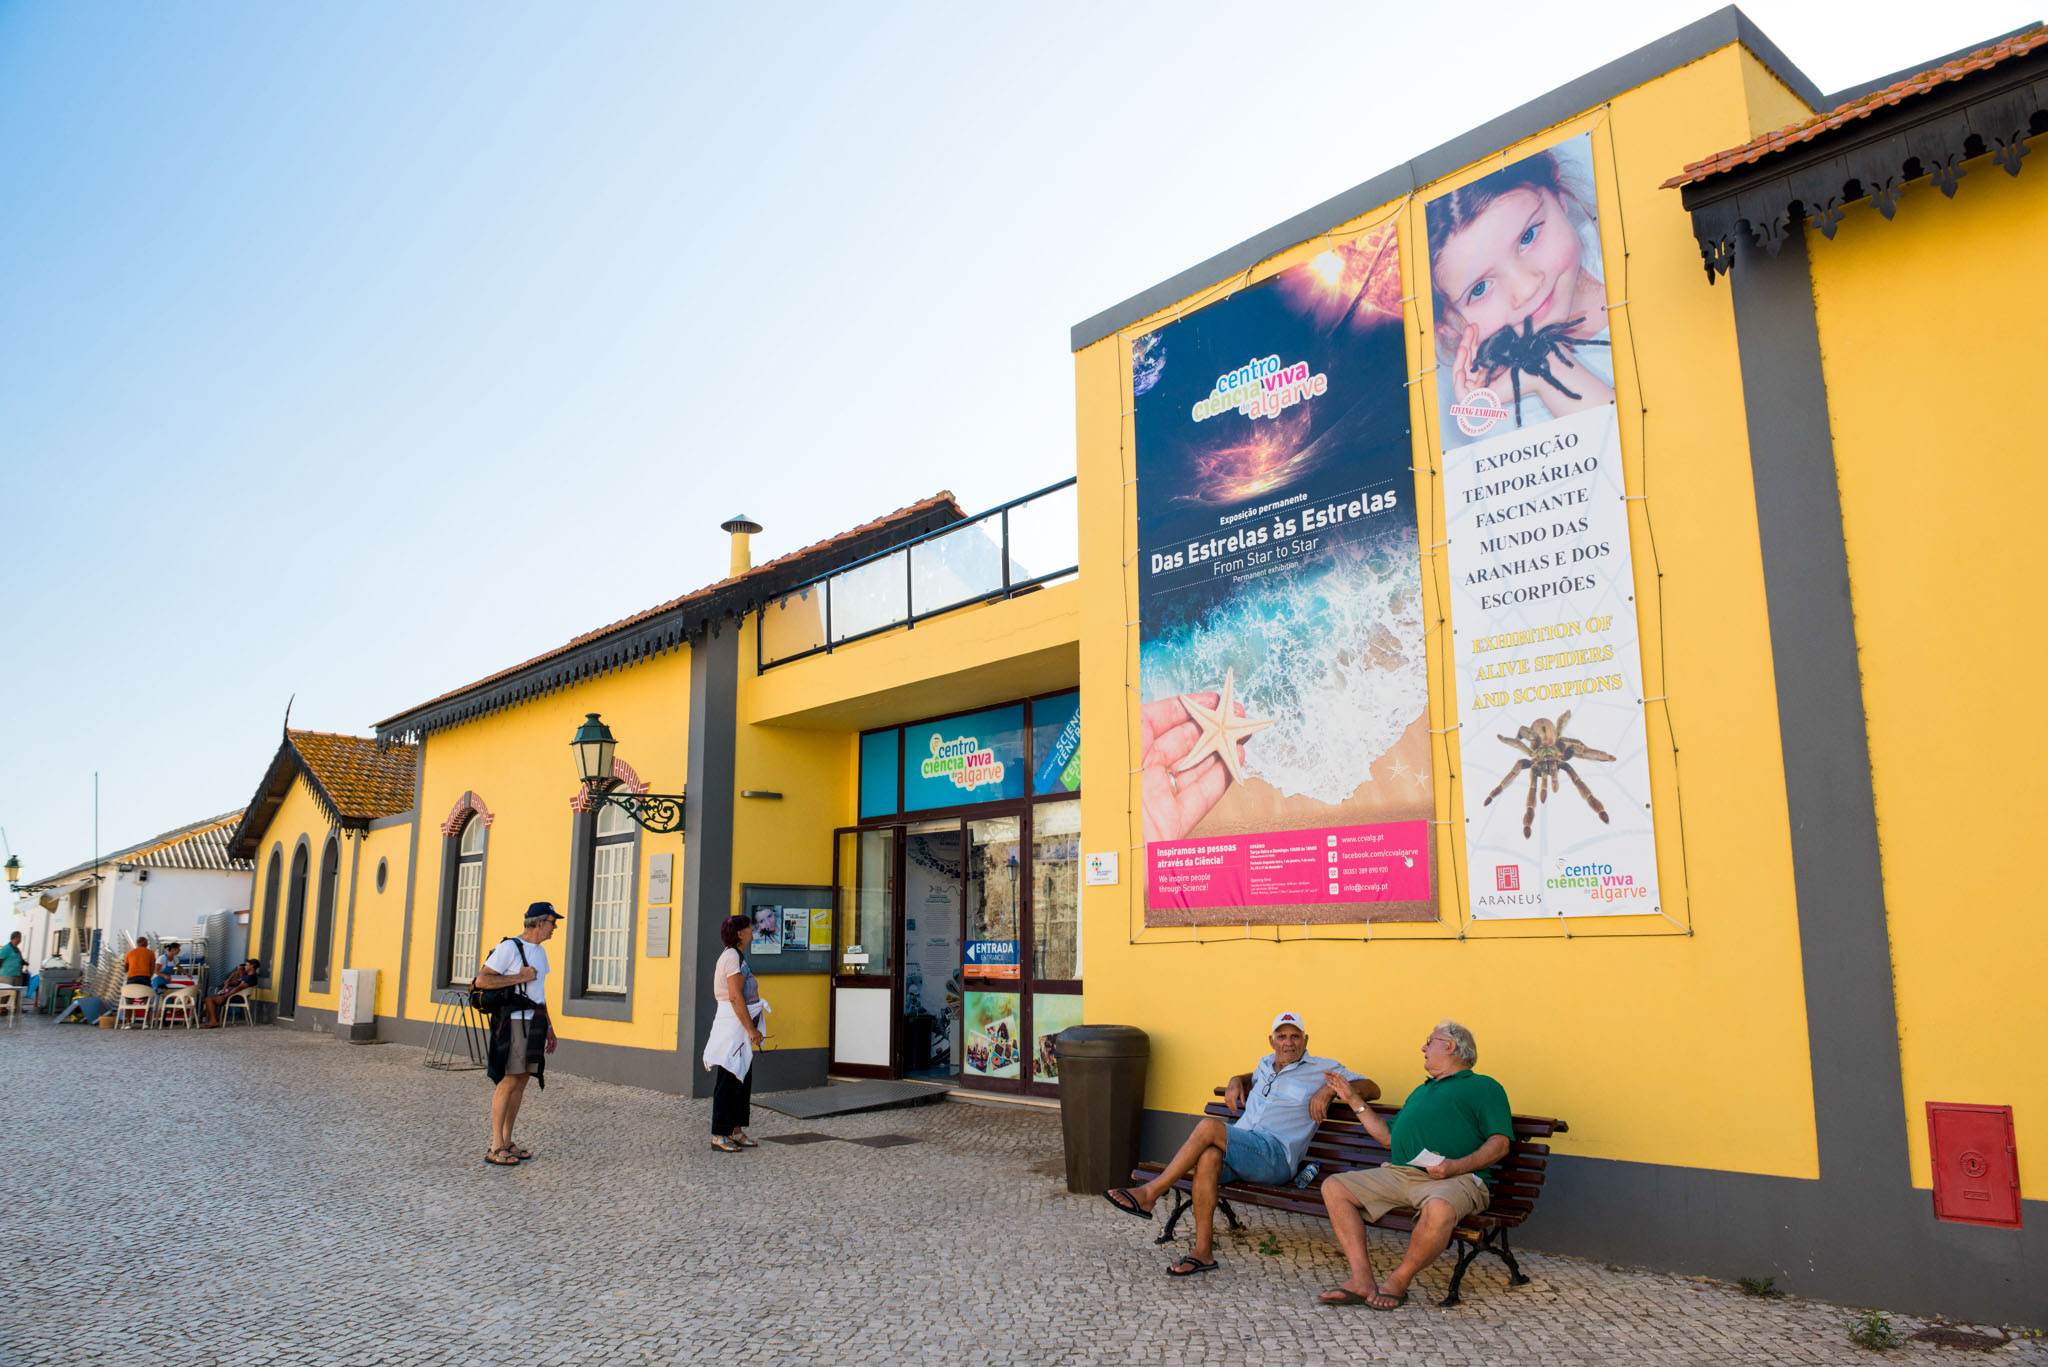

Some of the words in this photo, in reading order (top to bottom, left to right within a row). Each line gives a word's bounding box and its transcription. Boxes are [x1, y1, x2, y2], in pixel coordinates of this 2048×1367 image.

[1218, 357, 1279, 393] centro
[1193, 382, 1261, 420] ciência
[1265, 363, 1307, 392] viva
[1250, 375, 1325, 416] algarve
[1451, 406, 1473, 415] LIVING
[1475, 408, 1508, 418] EXHIBITS
[1475, 433, 1579, 474] EXPOSIÇÃO
[1462, 456, 1598, 504] TEMPORÁRIAO
[1220, 507, 1257, 526] Exposição
[1258, 493, 1308, 516] permanente
[1475, 488, 1589, 528] FASCINANTE
[1151, 552, 1184, 574] Das
[1188, 525, 1269, 564] Estrelas
[1273, 516, 1297, 540] às
[1301, 489, 1397, 532] Estrelas
[1480, 526, 1547, 555] MUNDO
[1552, 517, 1589, 539] DAS
[1213, 558, 1244, 576] From
[1247, 548, 1273, 567] Star
[1276, 545, 1289, 559] to
[1291, 537, 1319, 555] Star
[1464, 555, 1550, 586] ARANHAS
[1555, 551, 1567, 567] E
[1572, 541, 1610, 563] DOS
[1233, 568, 1267, 584] Permanent
[1268, 561, 1299, 575] exhibition
[1480, 574, 1596, 611] ESCORPIÕES
[1472, 620, 1581, 654] EXHIBITION
[1586, 615, 1613, 633] OF
[1474, 658, 1531, 682] ALIVE
[1534, 644, 1614, 672] SPIDERS
[1472, 691, 1509, 711] AND
[1513, 673, 1623, 705] SCORPIONS
[1056, 705, 1080, 751] SCIENC
[938, 740, 976, 759] centro
[1057, 722, 1080, 767] CENTR
[923, 756, 964, 775] ciência
[967, 752, 992, 768] viva
[956, 765, 1002, 788] algarve
[1157, 847, 1196, 858] Inspiramos
[1197, 846, 1206, 854] as
[1207, 844, 1237, 855] pessoas
[1341, 834, 1384, 844] www.ccvalg.pt
[1157, 858, 1184, 869] através
[1185, 857, 1194, 867] da
[1194, 855, 1224, 866] Ciência!
[1342, 849, 1419, 860] facebook.com/ccvalgarve
[1158, 874, 1168, 883] We
[1169, 874, 1189, 883] inspire
[1190, 872, 1211, 883] people
[1546, 874, 1599, 889] ciência
[1602, 874, 1634, 887] viva
[1565, 862, 1613, 877] centro
[1159, 884, 1181, 895] through
[1182, 883, 1208, 893] Science!
[1343, 883, 1389, 893] info@ccvalg.pt
[1478, 894, 1542, 906] ARANEUS
[1591, 884, 1648, 903] algarve
[976, 943, 1014, 954] ENTRADA
